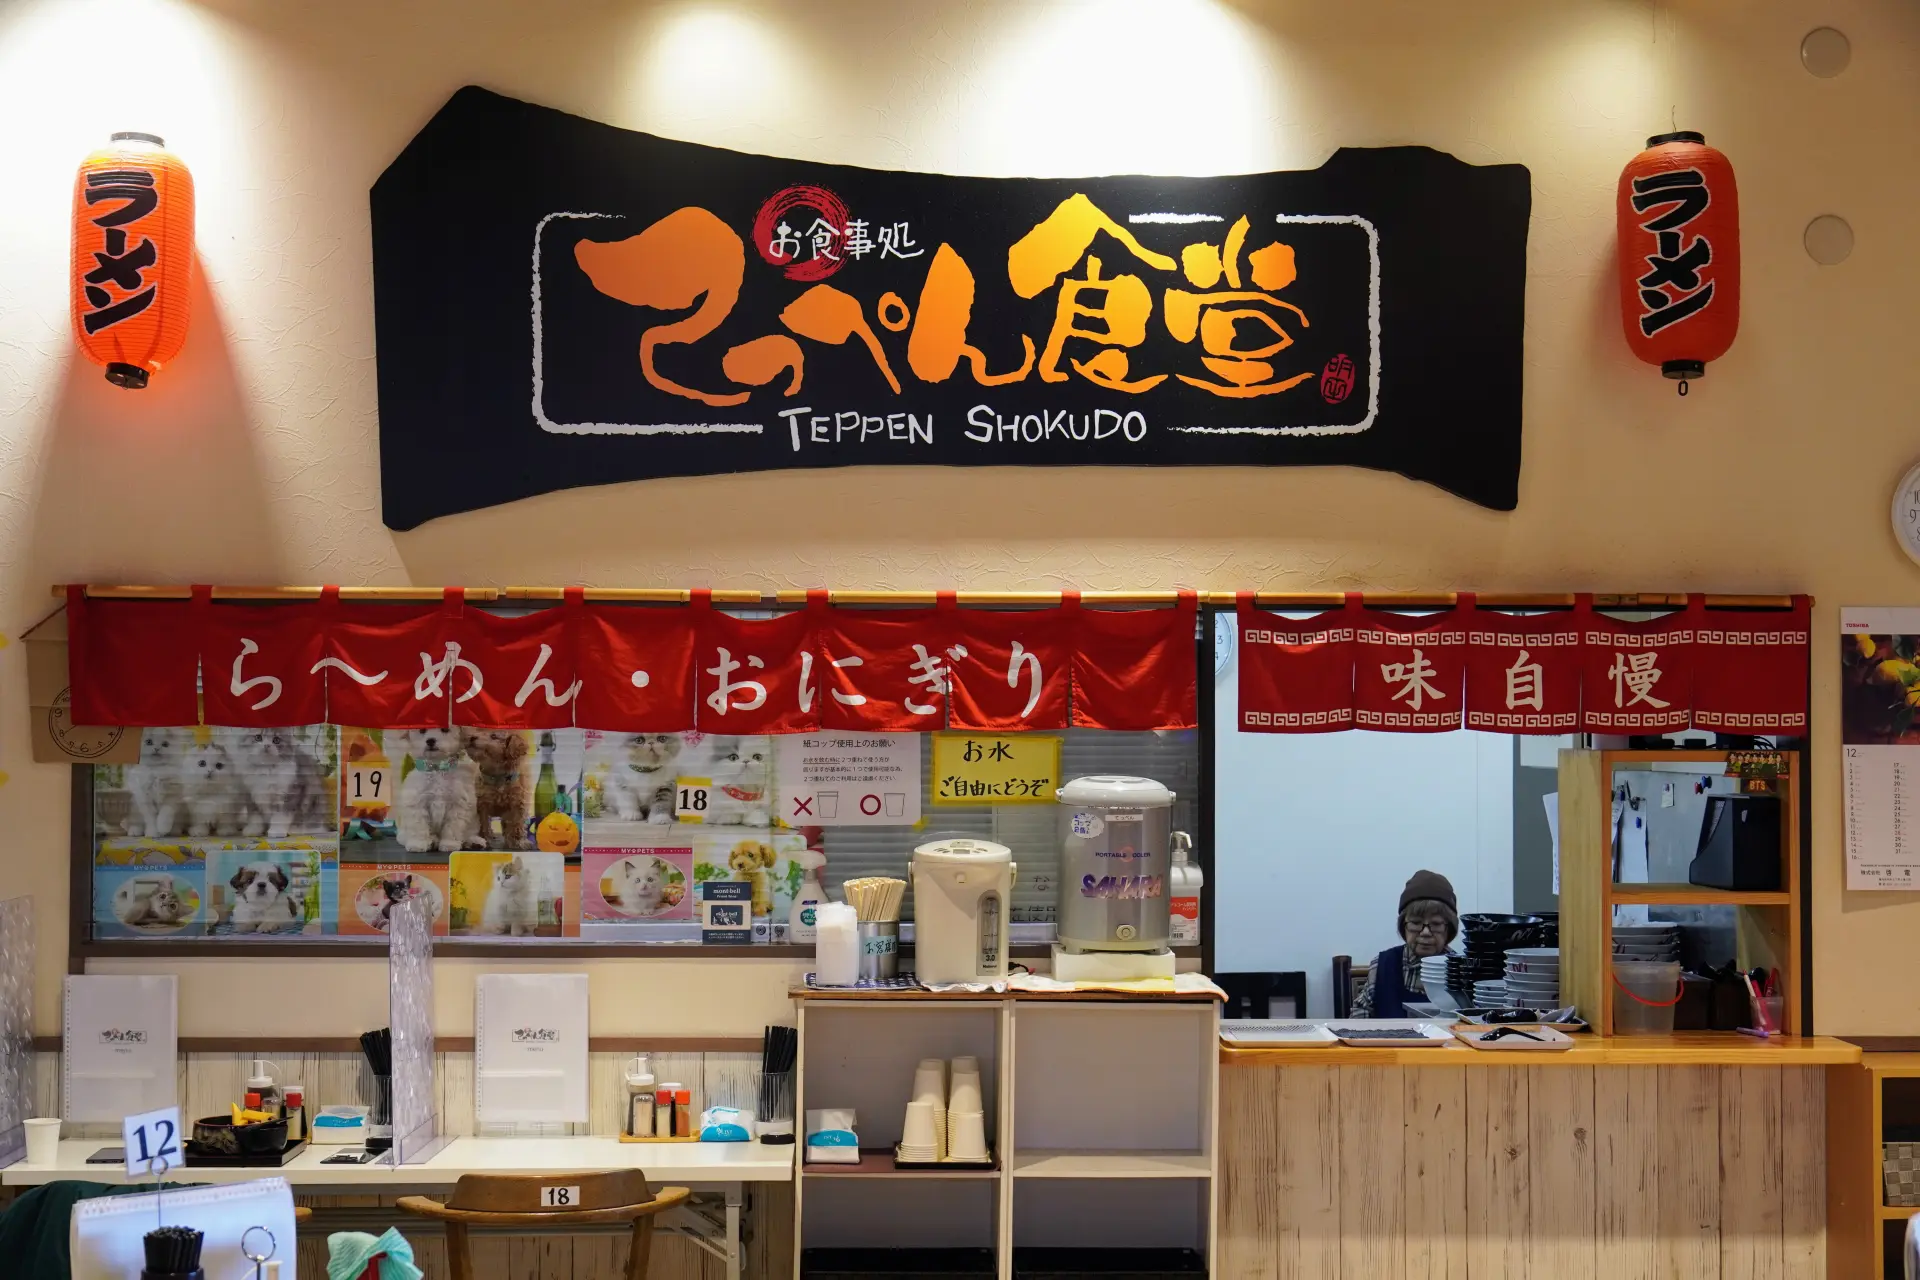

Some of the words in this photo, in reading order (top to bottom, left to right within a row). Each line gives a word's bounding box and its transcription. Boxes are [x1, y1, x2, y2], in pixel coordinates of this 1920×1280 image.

[769, 217, 925, 261] お食事処
[84, 170, 159, 336] ラーメン
[1630, 166, 1715, 338] ラーメン
[573, 192, 1316, 407] てっぺん食堂
[777, 406, 934, 452] TEPPEN
[964, 404, 1148, 443] SHOKUDO
[1910, 508, 1917, 524] 9
[1380, 648, 1671, 712] 味自慢
[803, 739, 896, 748] 紙コップ使用上のお願い
[963, 740, 1015, 762] お水
[1846, 748, 1857, 758] 12
[354, 771, 382, 798] 19
[940, 775, 1050, 797] ご自由にどうぞ
[1749, 780, 1766, 790] BTS
[679, 789, 707, 811] 18
[1081, 874, 1164, 899] SAHARA
[985, 954, 995, 962] 3.0
[133, 1120, 177, 1162] 12
[548, 1187, 570, 1205] 18
